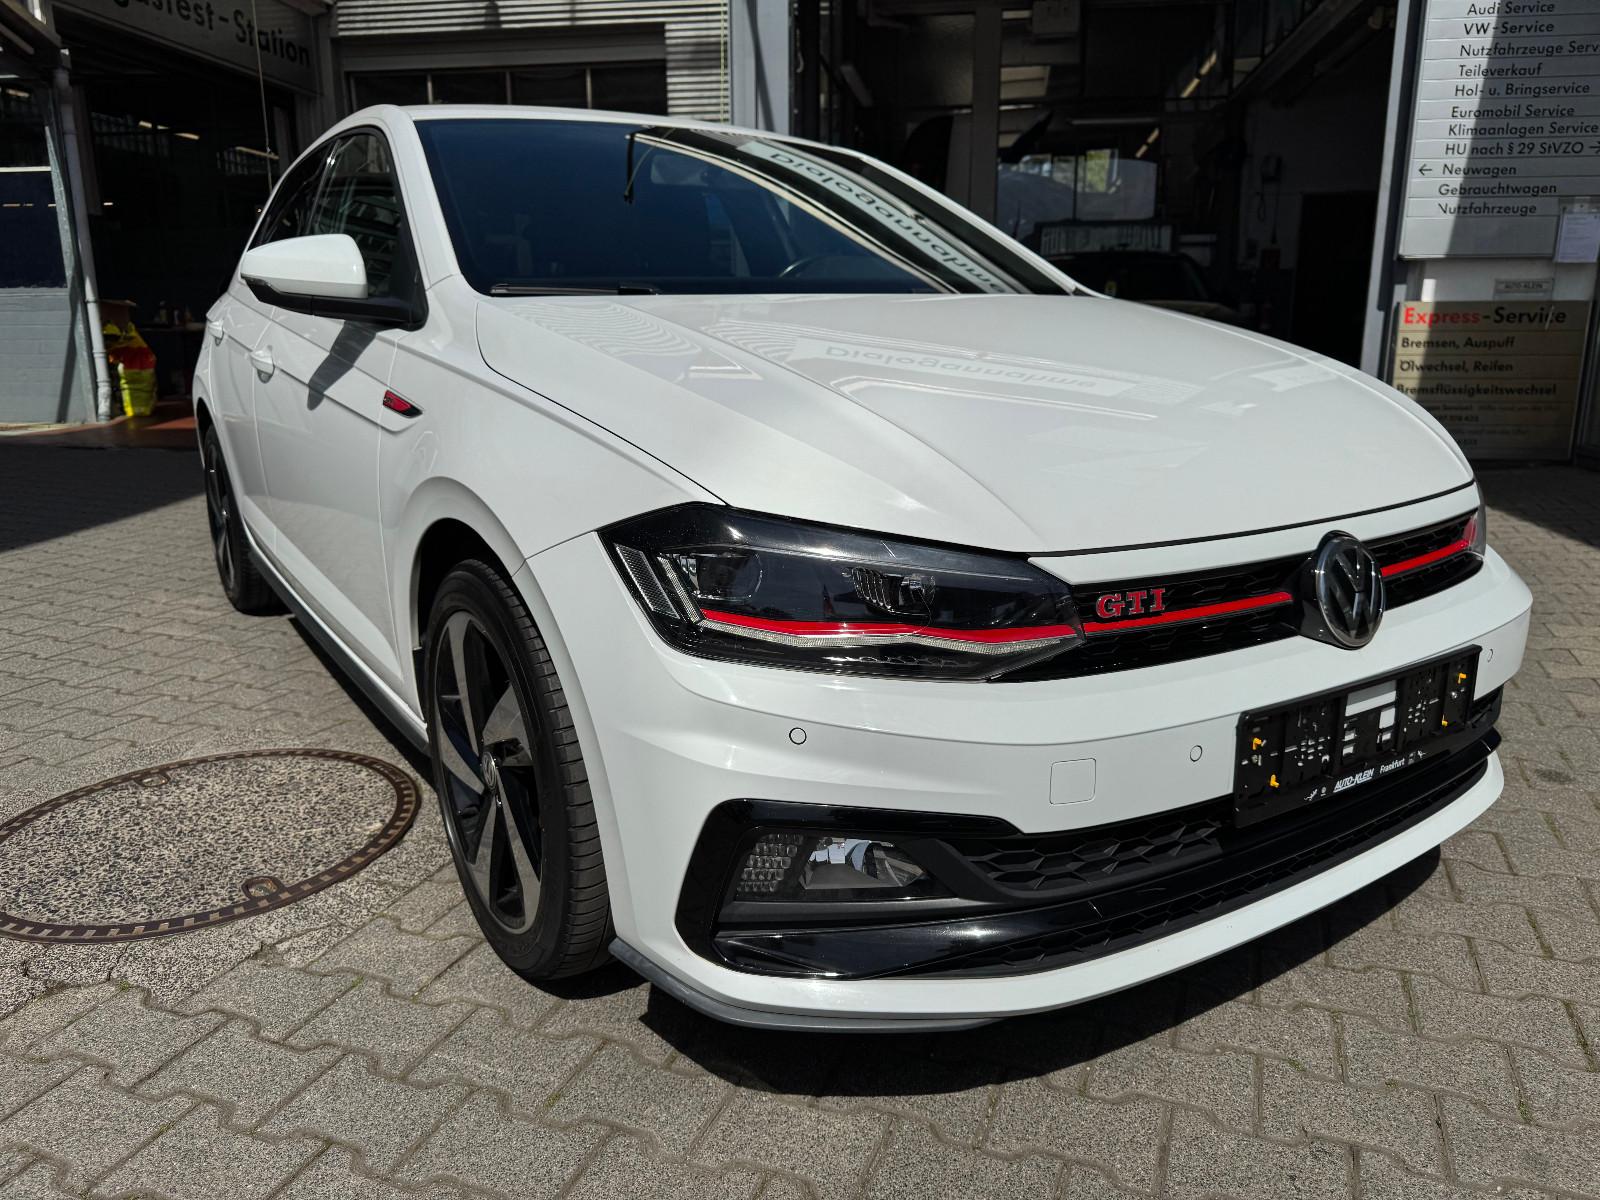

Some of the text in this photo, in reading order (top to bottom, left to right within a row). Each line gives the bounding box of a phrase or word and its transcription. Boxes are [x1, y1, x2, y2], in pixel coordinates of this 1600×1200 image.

[1467, 1, 1555, 16] Audi Service
[1460, 42, 1563, 57] Nutzfahrzeuge
[1459, 63, 1543, 77] Teileverkauf
[1455, 82, 1590, 98] Hol- u. Bringservice
[1451, 104, 1575, 119] Euromobil Service
[1448, 121, 1599, 138] Klimaanlagen Service
[1445, 143, 1466, 155] HU
[1470, 142, 1503, 155] nach
[1518, 143, 1535, 155] 29
[1538, 142, 1584, 155] StVZO
[1442, 163, 1517, 178] Neuwagen
[1438, 183, 1557, 197] Gebrauchtwagen
[1438, 202, 1537, 217] Nutzfahrzeuge
[1402, 336, 1515, 351] Bremsen, Auspuff
[1400, 359, 1514, 374] Ölwechsel, Reifen
[1096, 587, 1166, 619] GTI
[1380, 757, 1406, 775] Frankfurt
